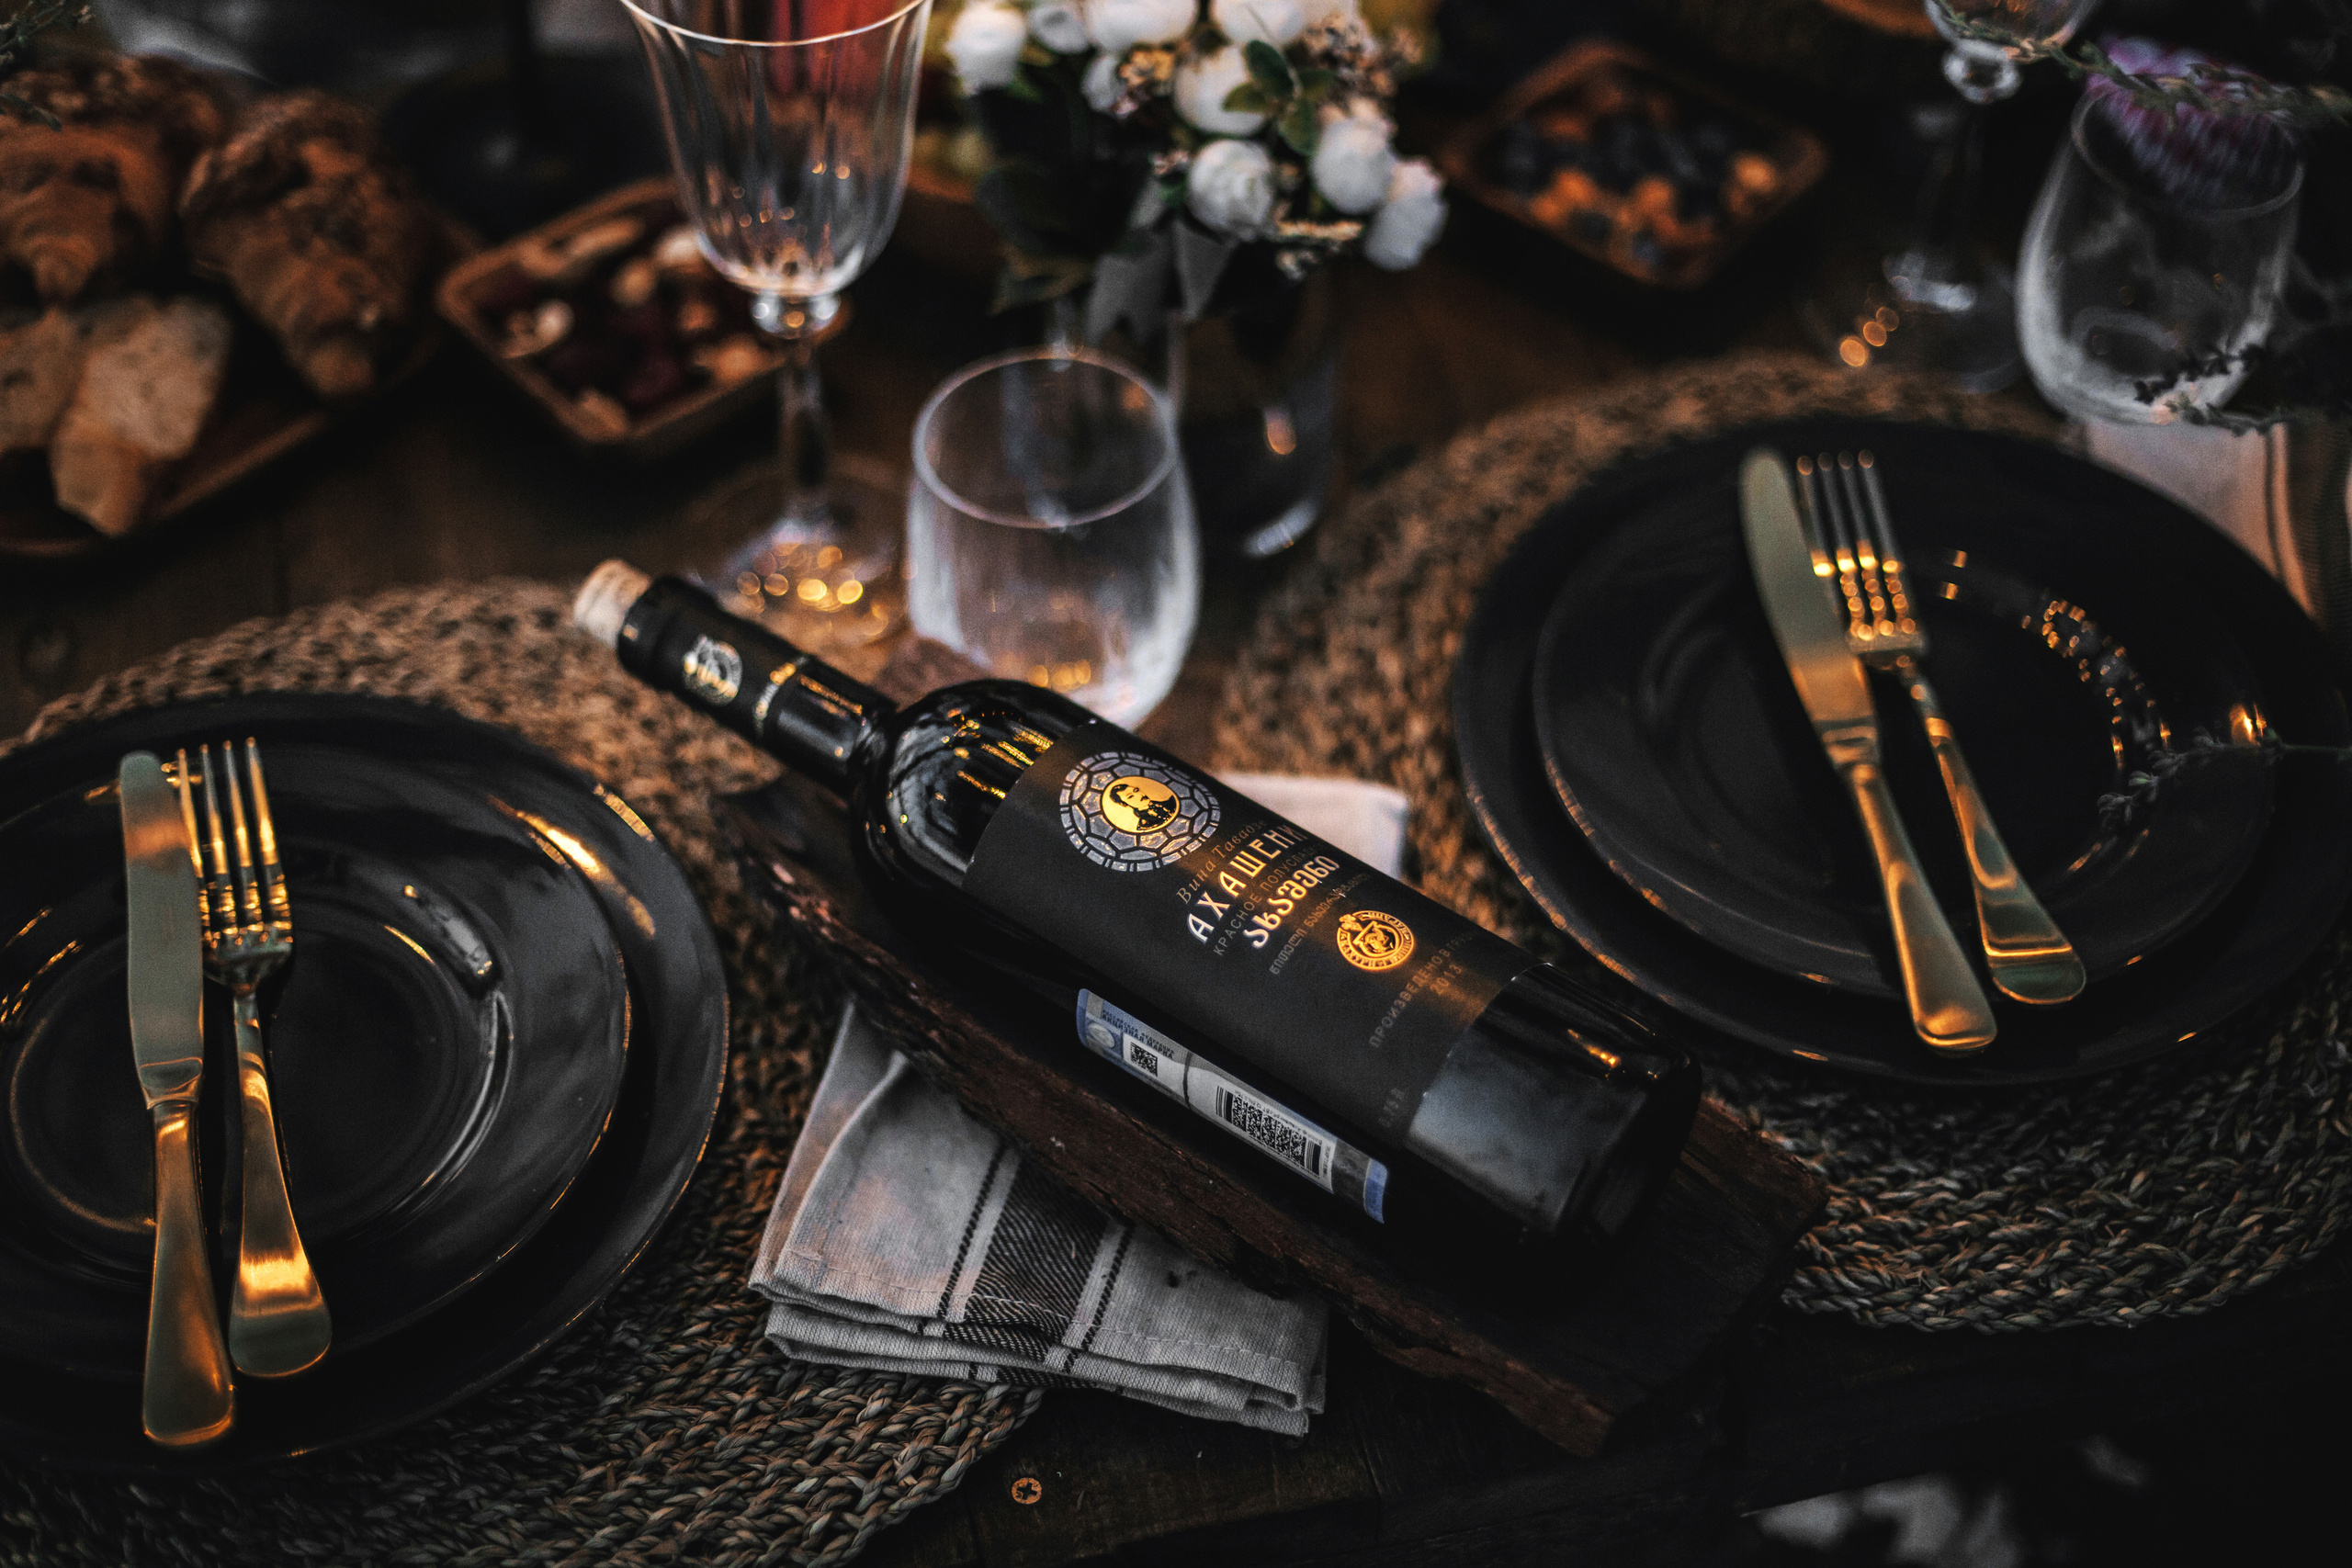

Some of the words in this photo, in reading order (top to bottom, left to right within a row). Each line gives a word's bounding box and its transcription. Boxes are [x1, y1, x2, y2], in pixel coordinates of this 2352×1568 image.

[1176, 860, 1216, 904] Вина
[1213, 893, 1262, 955] КРАСНОЕ
[1102, 1014, 1145, 1042] АКЦИЗНАЯ
[1147, 1038, 1173, 1059] МАРКА
